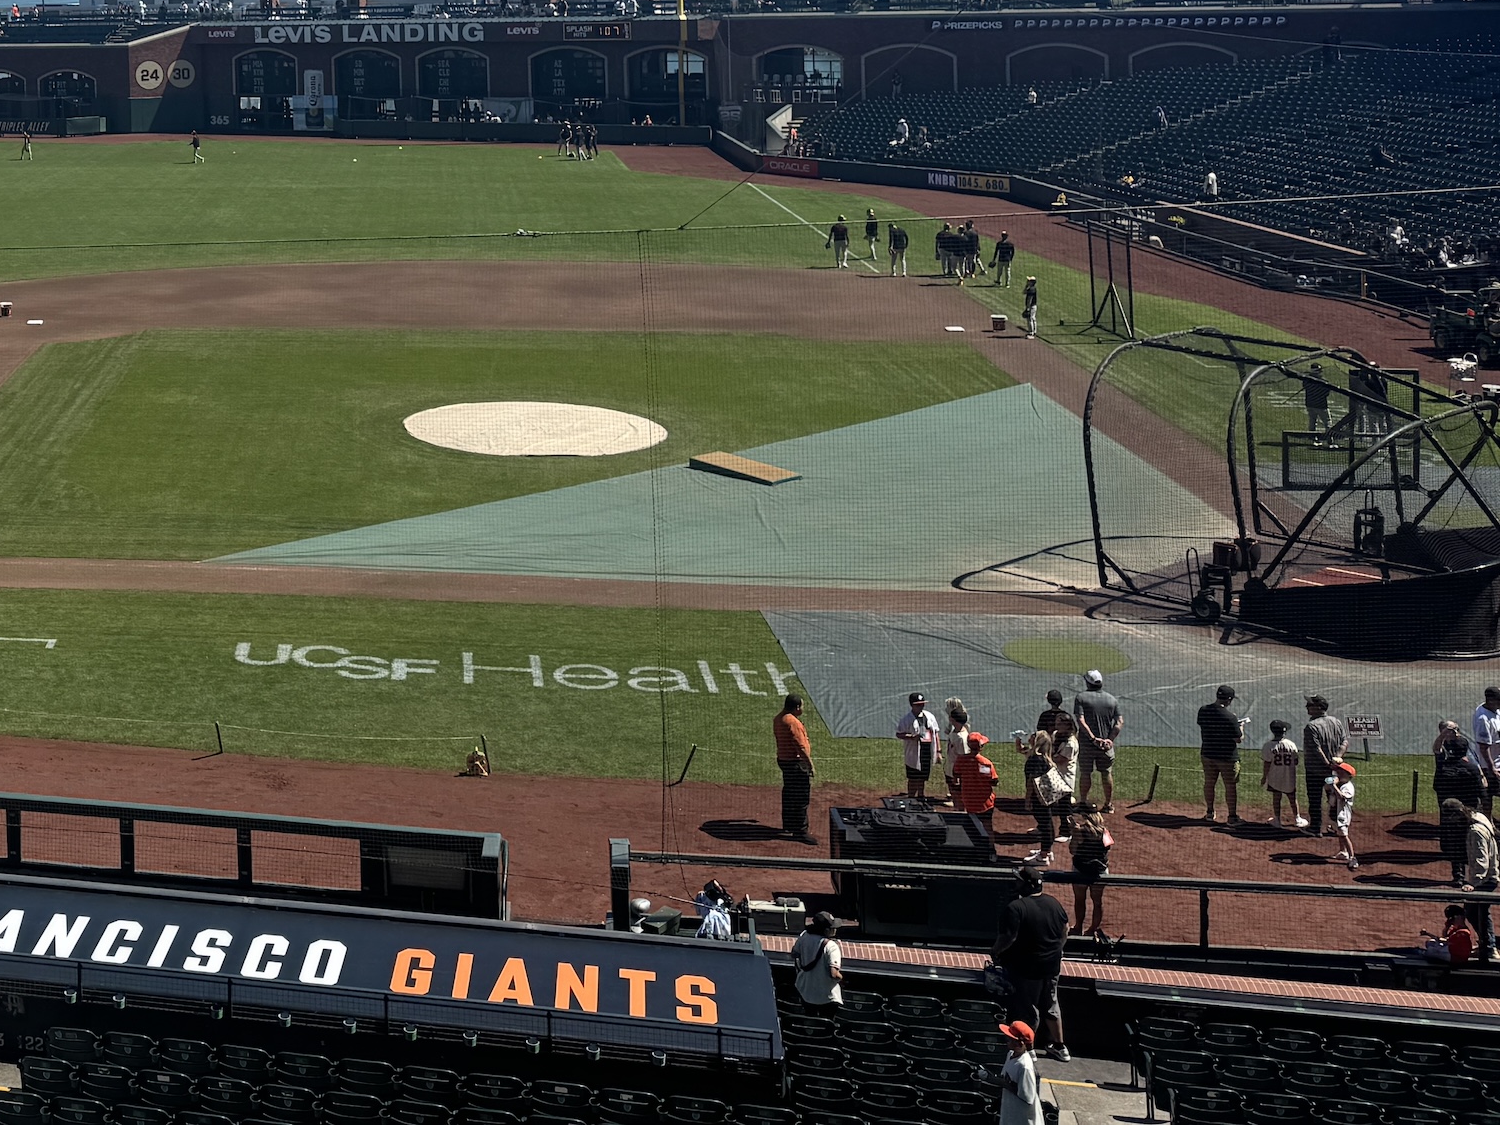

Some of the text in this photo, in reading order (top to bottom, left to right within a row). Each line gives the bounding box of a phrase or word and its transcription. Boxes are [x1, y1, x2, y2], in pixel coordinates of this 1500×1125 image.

[566, 25, 592, 33] SPLASH
[599, 26, 620, 36] 107
[944, 21, 1003, 30] PRIZEPICKS
[342, 23, 484, 43] LANDING
[141, 69, 160, 81] 24
[173, 67, 190, 80] 30
[308, 75, 318, 107] Corona
[27, 121, 50, 131] ALLEY
[210, 115, 230, 125] 365
[769, 161, 811, 173] ORACLE
[928, 173, 956, 187] KNBR
[986, 179, 1004, 191] 680
[234, 641, 800, 698] UCSF Health
[390, 947, 718, 1025] GIANTS
